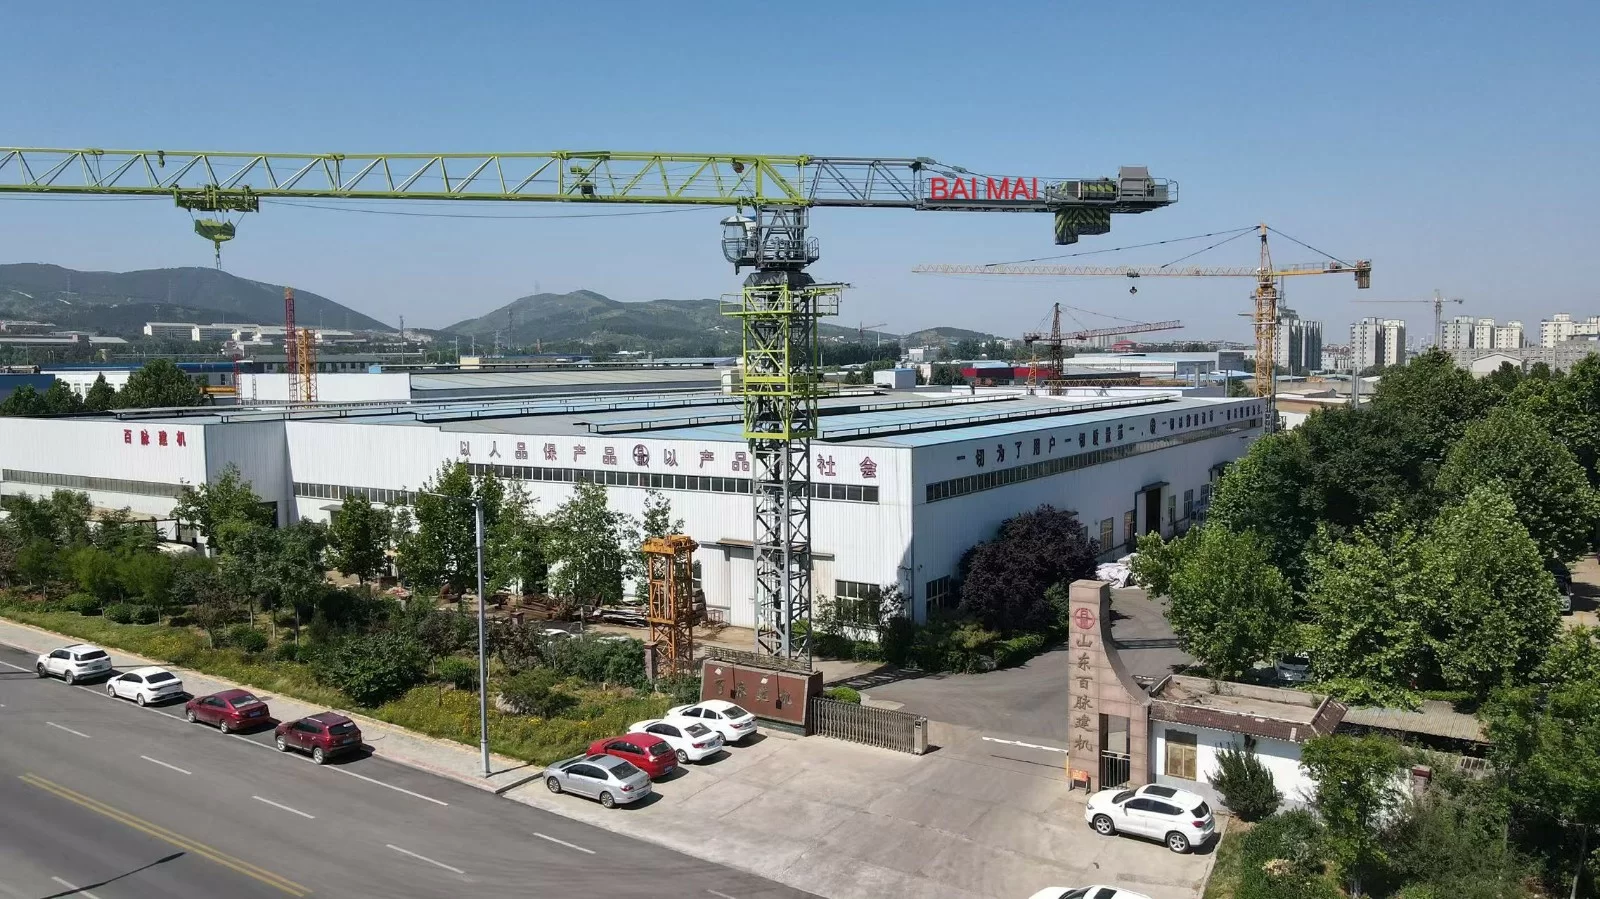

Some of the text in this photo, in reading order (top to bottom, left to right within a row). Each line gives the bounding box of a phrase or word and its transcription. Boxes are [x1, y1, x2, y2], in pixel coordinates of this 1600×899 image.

[931, 176, 1038, 200] BAI MAI
[459, 440, 878, 479] 以人品保产品 以产品社会
[1073, 633, 1094, 753] 山东百脉建机
